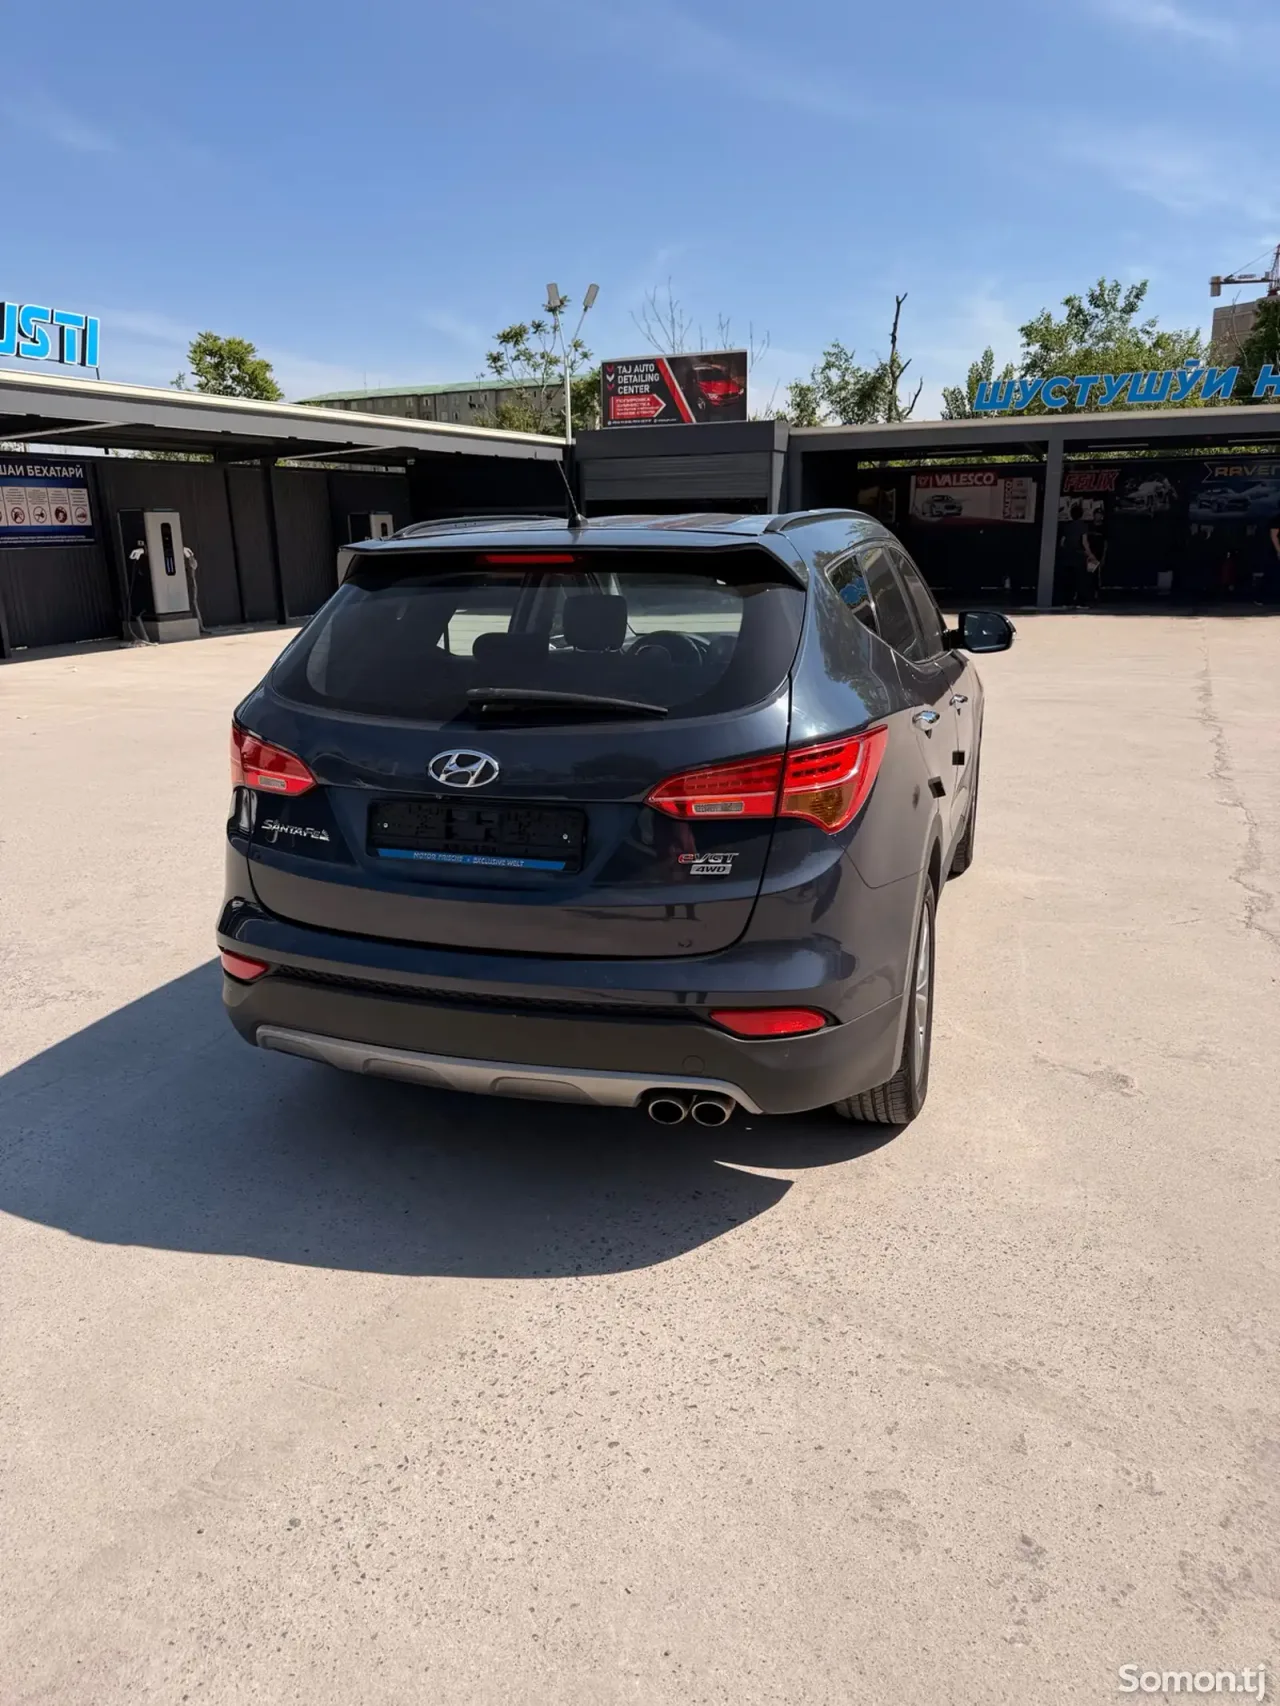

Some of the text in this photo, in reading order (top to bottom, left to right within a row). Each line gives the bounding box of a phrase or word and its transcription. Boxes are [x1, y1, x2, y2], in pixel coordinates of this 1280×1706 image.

[617, 363, 655, 374] TAJ AUTO
[617, 373, 660, 384] DETAILING
[617, 384, 650, 395] CENTER
[934, 472, 995, 487] VALESCO
[695, 865, 726, 874] 4WD
